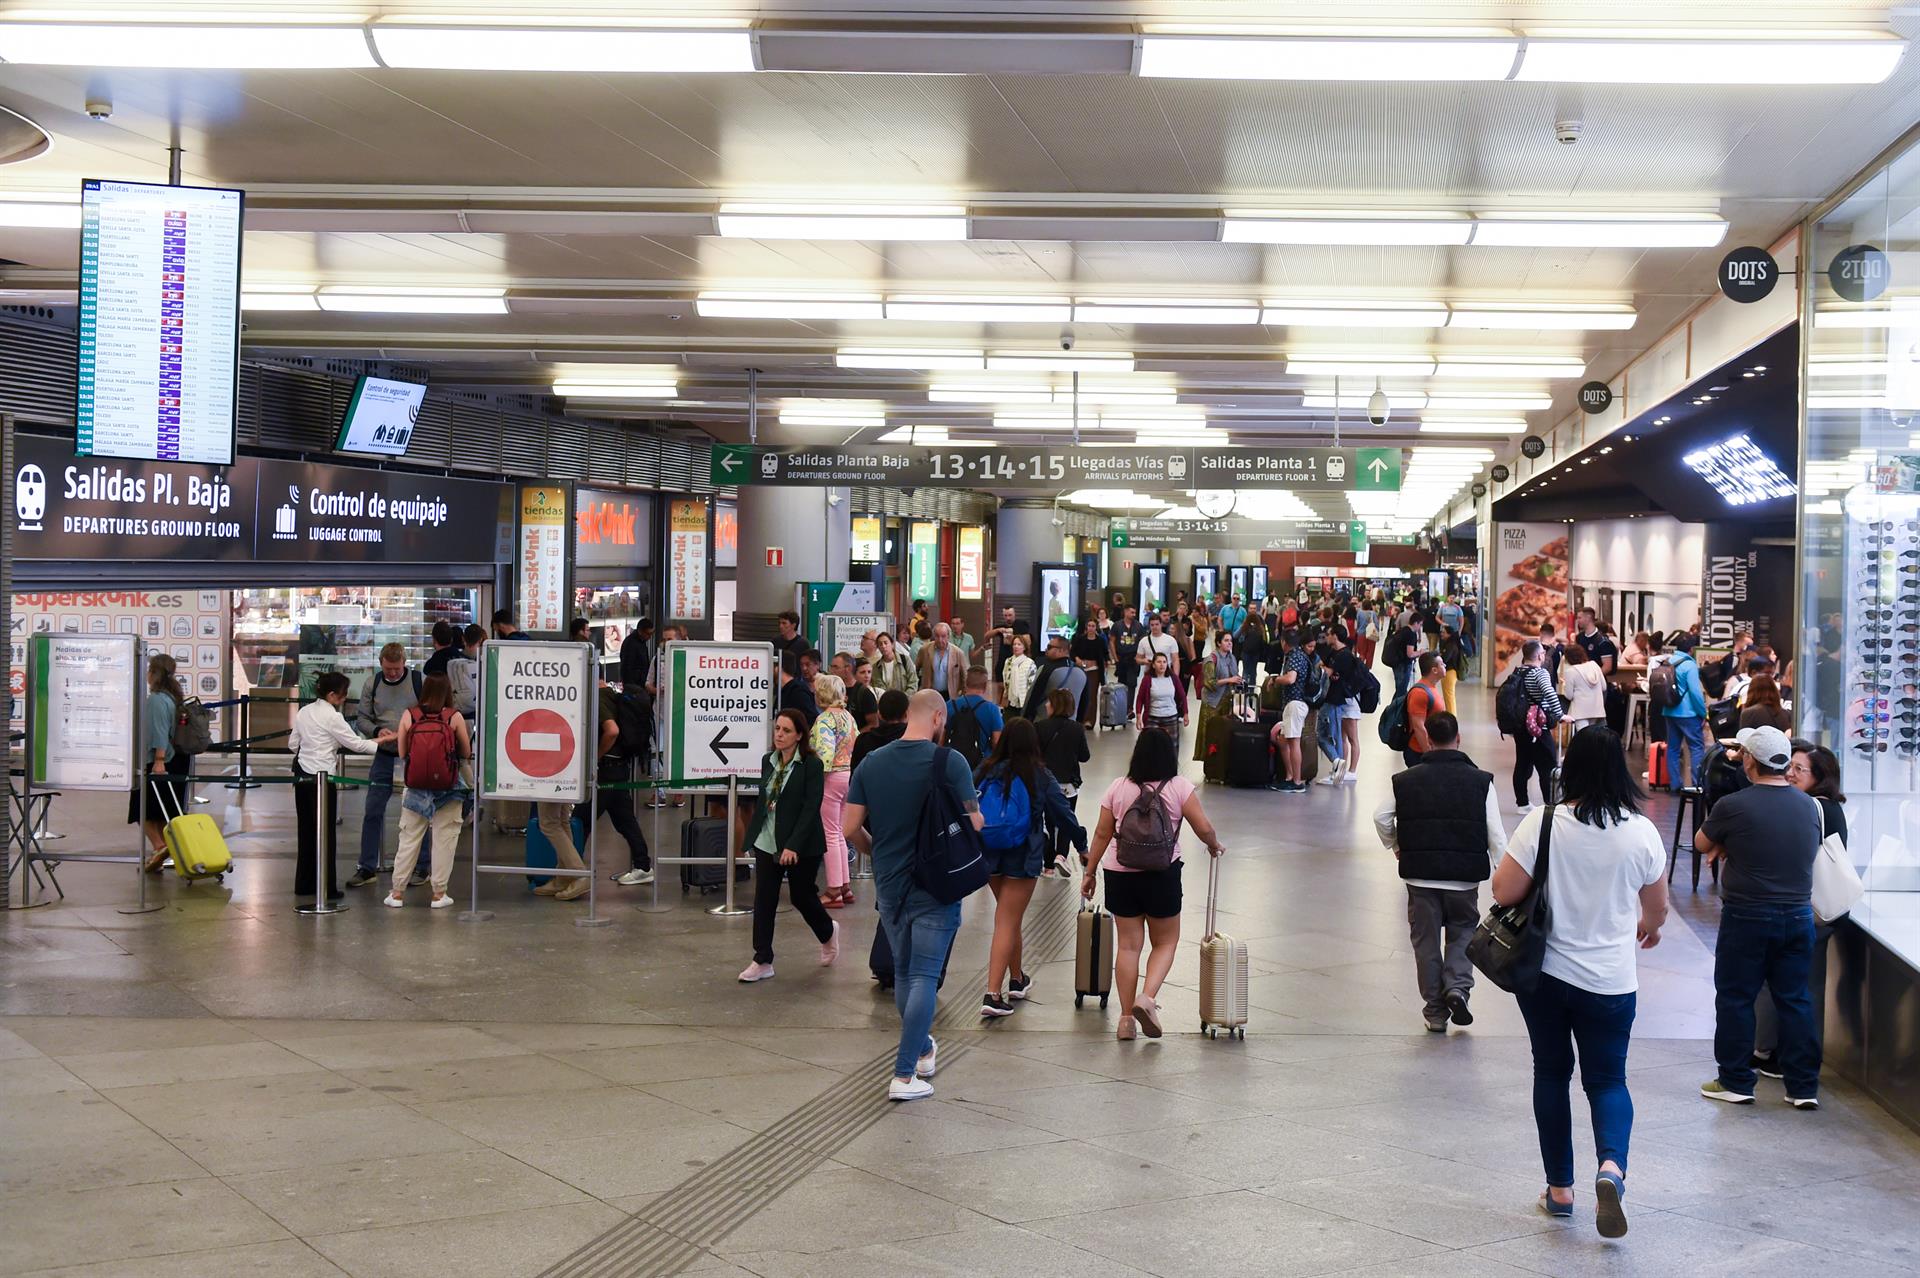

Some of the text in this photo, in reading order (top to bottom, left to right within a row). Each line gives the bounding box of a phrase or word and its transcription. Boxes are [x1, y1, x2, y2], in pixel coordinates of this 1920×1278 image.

[1728, 261, 1767, 280] DOTS
[367, 384, 382, 392] Control
[390, 388, 411, 397] seguridad
[1584, 390, 1606, 402] DOTS
[1525, 442, 1541, 450] DOTS
[788, 454, 1316, 480] Salidas Planta Baja 13·14·15 Llegadas Vías Salidas Planta 1
[64, 466, 231, 514] Salidas Pl. Baja
[310, 488, 447, 526] Control de equipaje
[525, 506, 563, 515] tiendas
[64, 516, 240, 538] DEPARTURES GROUND FLOOR
[310, 527, 382, 542] LUGGAGE CONTROL
[1504, 529, 1526, 539] PIZZA
[525, 528, 541, 628] superskunk
[675, 534, 687, 617] superskunk
[1735, 557, 1747, 602] QUALITY
[839, 617, 870, 625] PUESTO
[513, 661, 570, 677] ACCESO
[700, 656, 759, 670] Entrada
[689, 676, 769, 689] Control de
[505, 684, 577, 702] CERRADO
[690, 695, 766, 712] equipajes
